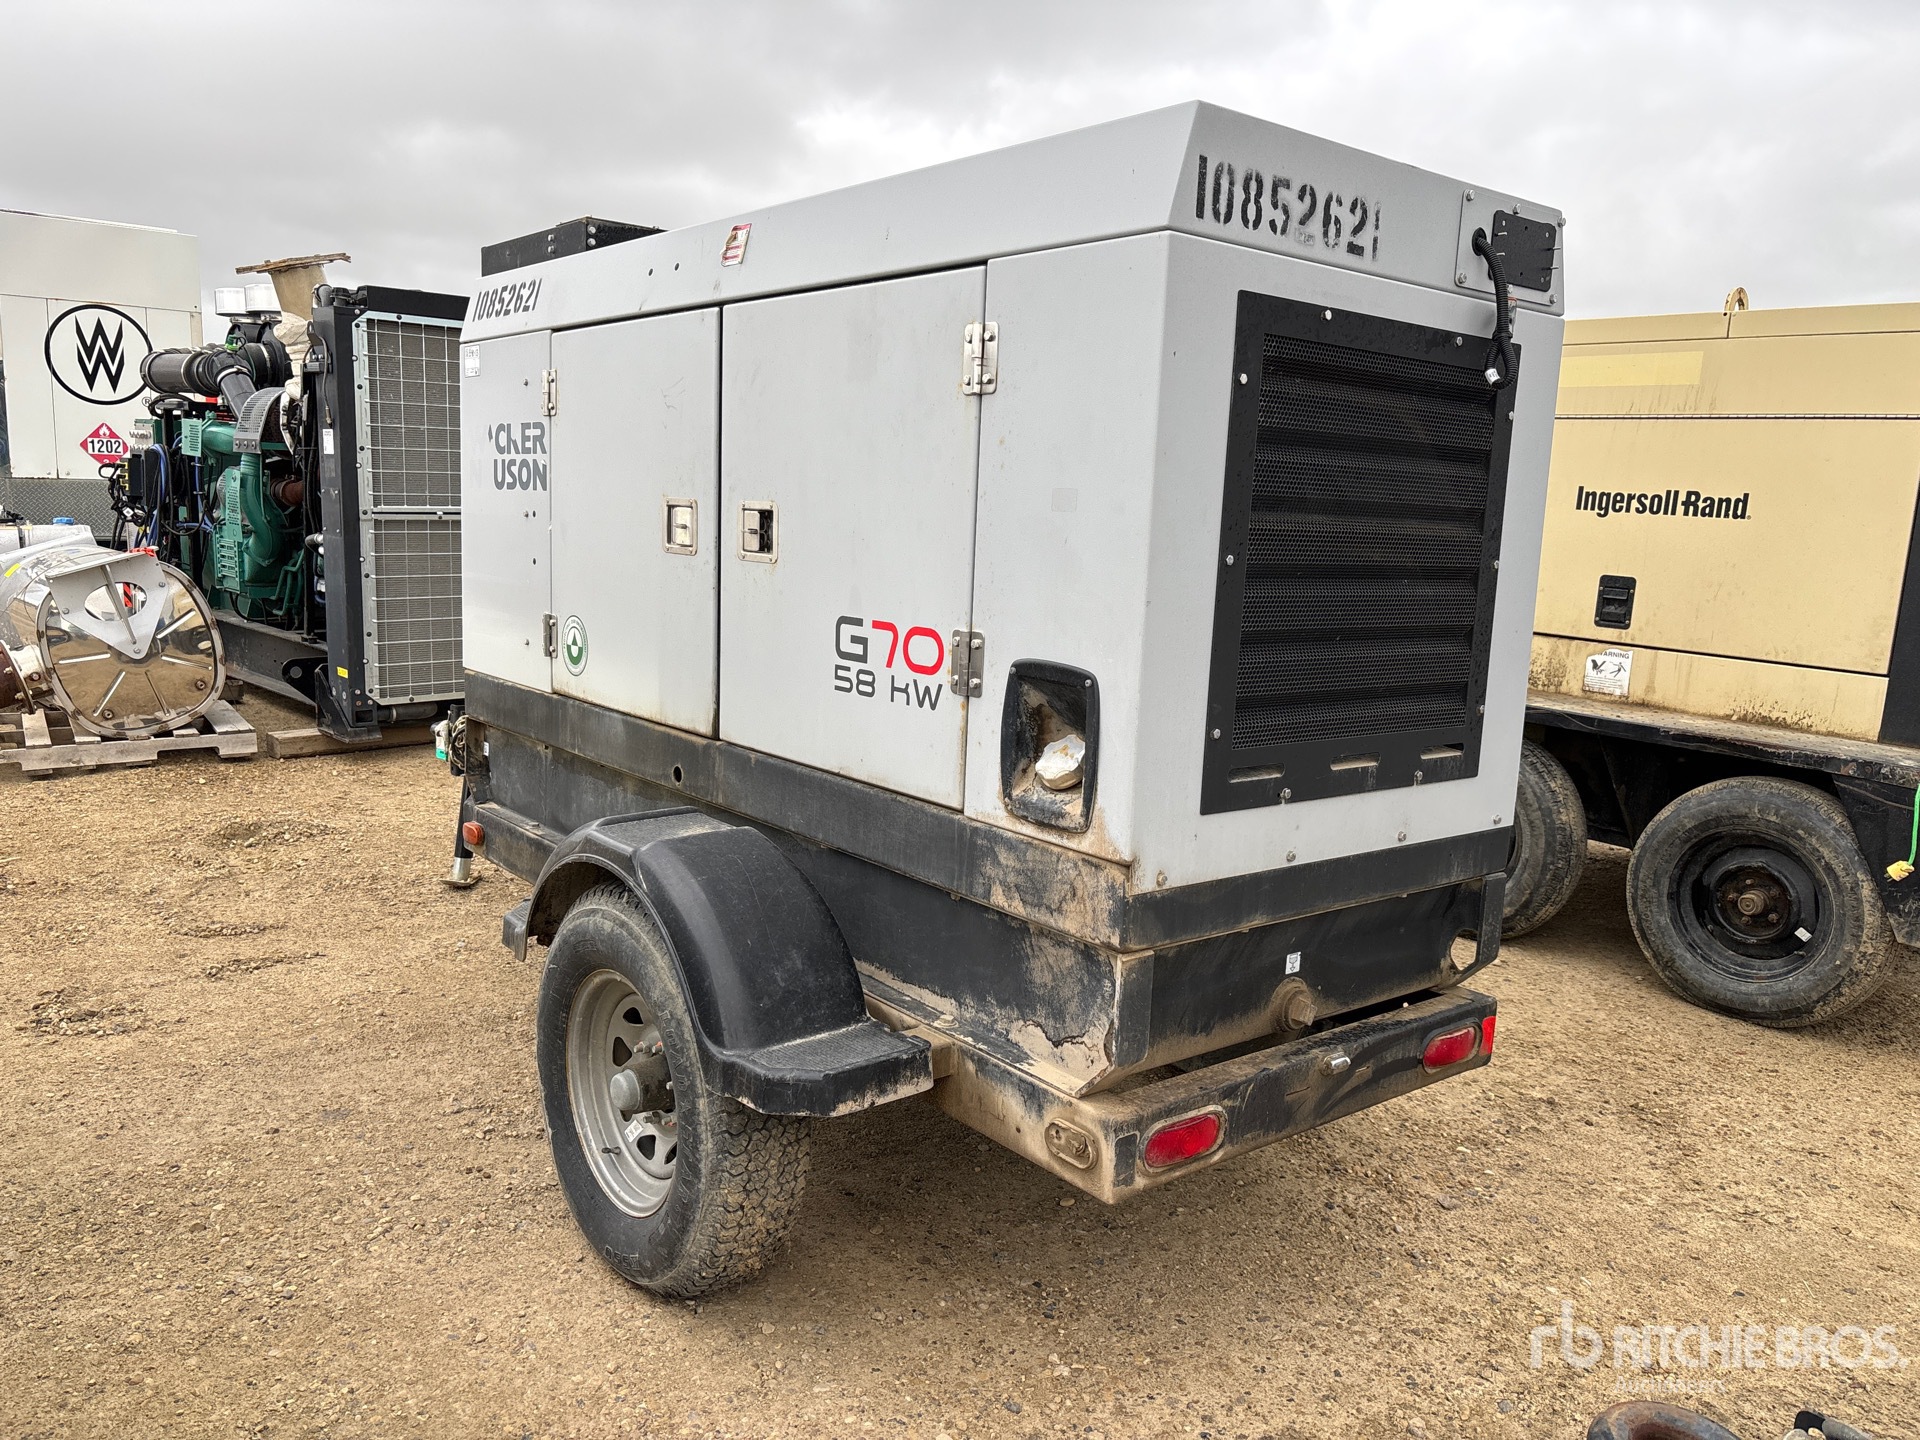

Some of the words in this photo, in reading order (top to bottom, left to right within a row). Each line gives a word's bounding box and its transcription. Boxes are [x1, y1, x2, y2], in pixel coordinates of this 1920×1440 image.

[1195, 154, 1384, 262] 10852621
[472, 279, 542, 322] 10852621
[88, 439, 122, 454] 1202
[835, 615, 945, 676] G70
[834, 664, 876, 698] 58
